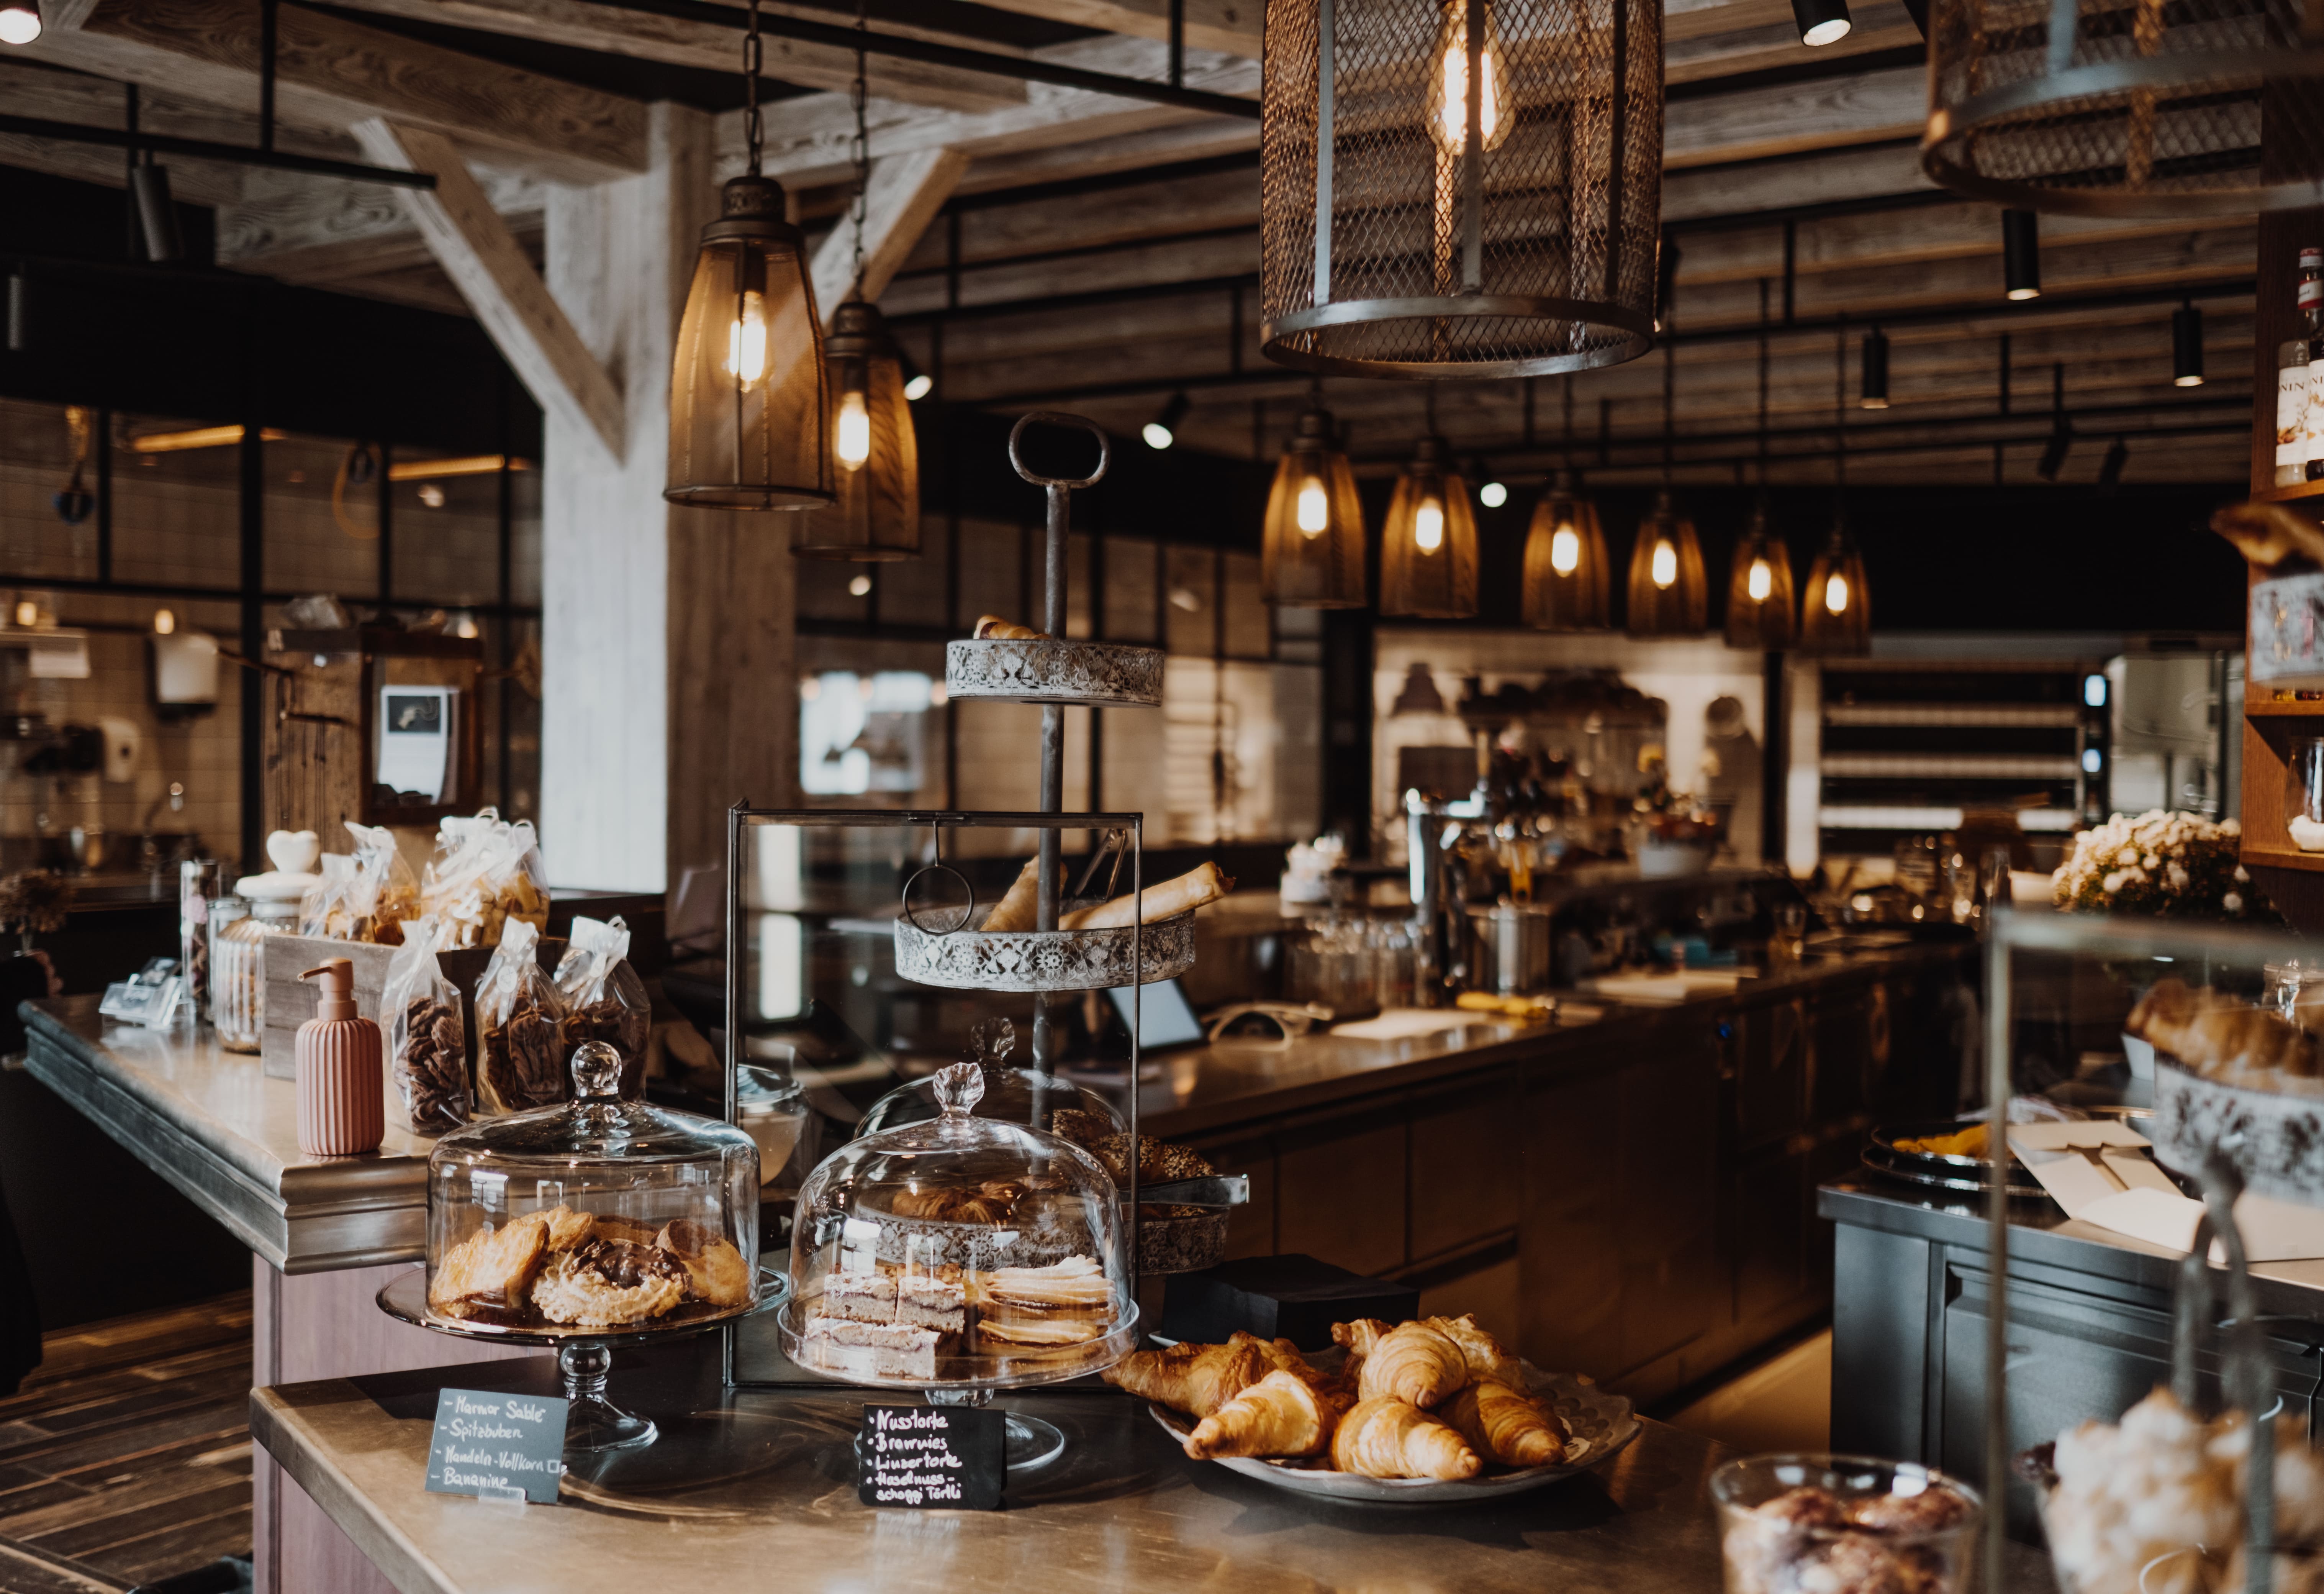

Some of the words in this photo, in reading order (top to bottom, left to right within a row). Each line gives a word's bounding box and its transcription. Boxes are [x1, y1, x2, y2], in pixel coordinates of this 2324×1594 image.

[455, 1395, 500, 1415] Marmor
[449, 1418, 524, 1442] Spitzbuben
[877, 1408, 948, 1431] Nusstorte
[875, 1432, 948, 1452] Brownies
[876, 1486, 923, 1505] schoggi
[925, 1482, 961, 1500] Törtli
